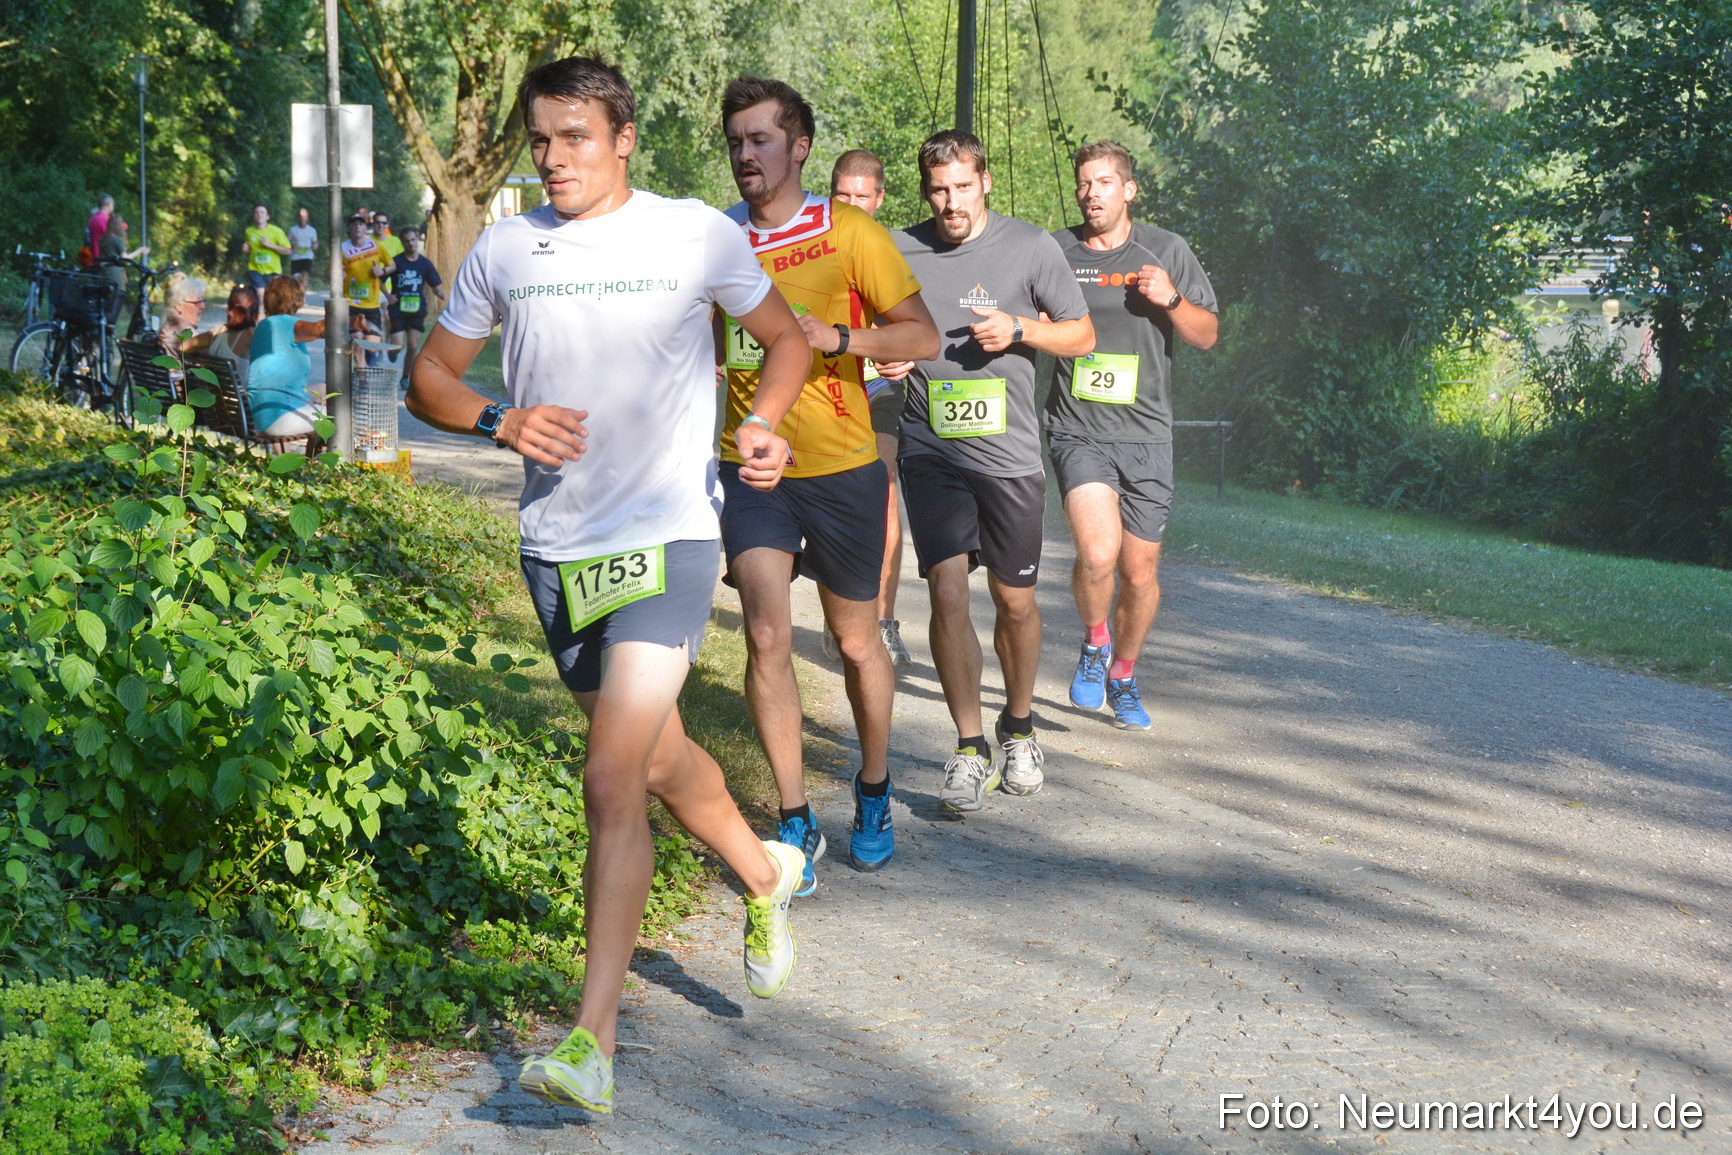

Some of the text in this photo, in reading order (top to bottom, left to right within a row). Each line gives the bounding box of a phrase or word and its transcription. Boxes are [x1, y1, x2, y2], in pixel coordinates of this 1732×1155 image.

[772, 239, 837, 273] BÖGL
[508, 279, 678, 302] RUPPRECHT HOLZBAU
[959, 298, 998, 306] BURKHARDT
[1090, 370, 1115, 389] 29
[944, 400, 988, 422] 320
[574, 552, 648, 600] 1753
[584, 580, 642, 609] Federhofer Felix
[626, 586, 644, 595] GmbH
